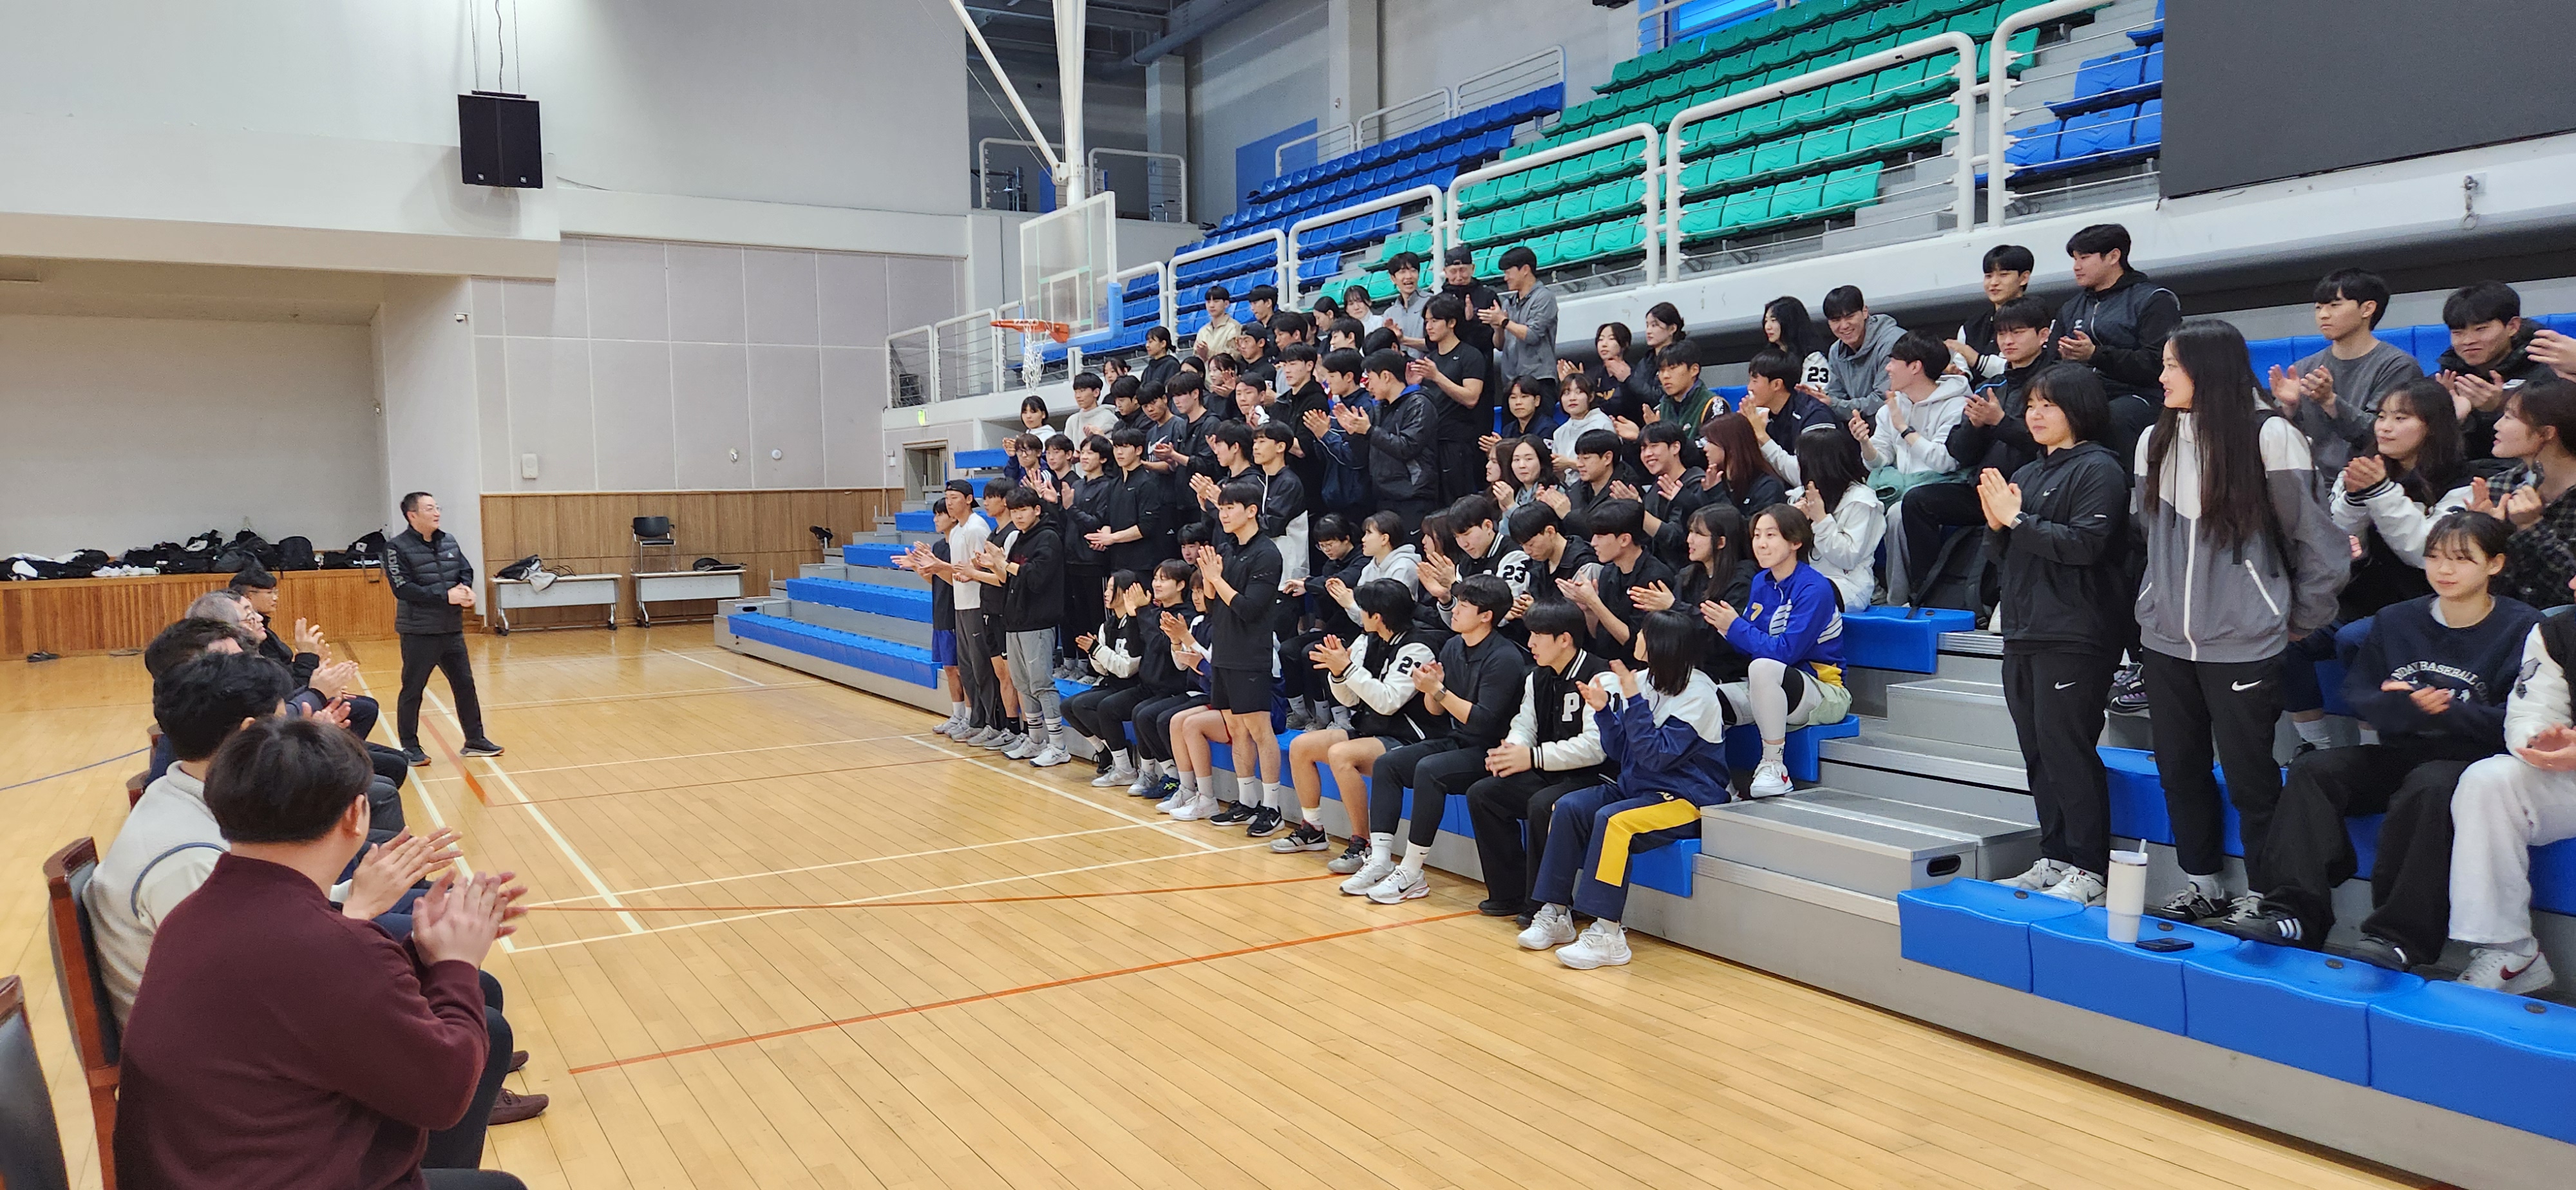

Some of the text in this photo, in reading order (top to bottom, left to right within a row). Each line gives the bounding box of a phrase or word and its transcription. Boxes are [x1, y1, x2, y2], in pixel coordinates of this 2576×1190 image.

[1807, 366, 1829, 383] 23
[1503, 565, 1526, 584] 23
[1750, 602, 1764, 621] 7
[2420, 661, 2478, 685] BASEBALL
[1562, 692, 1580, 721] P
